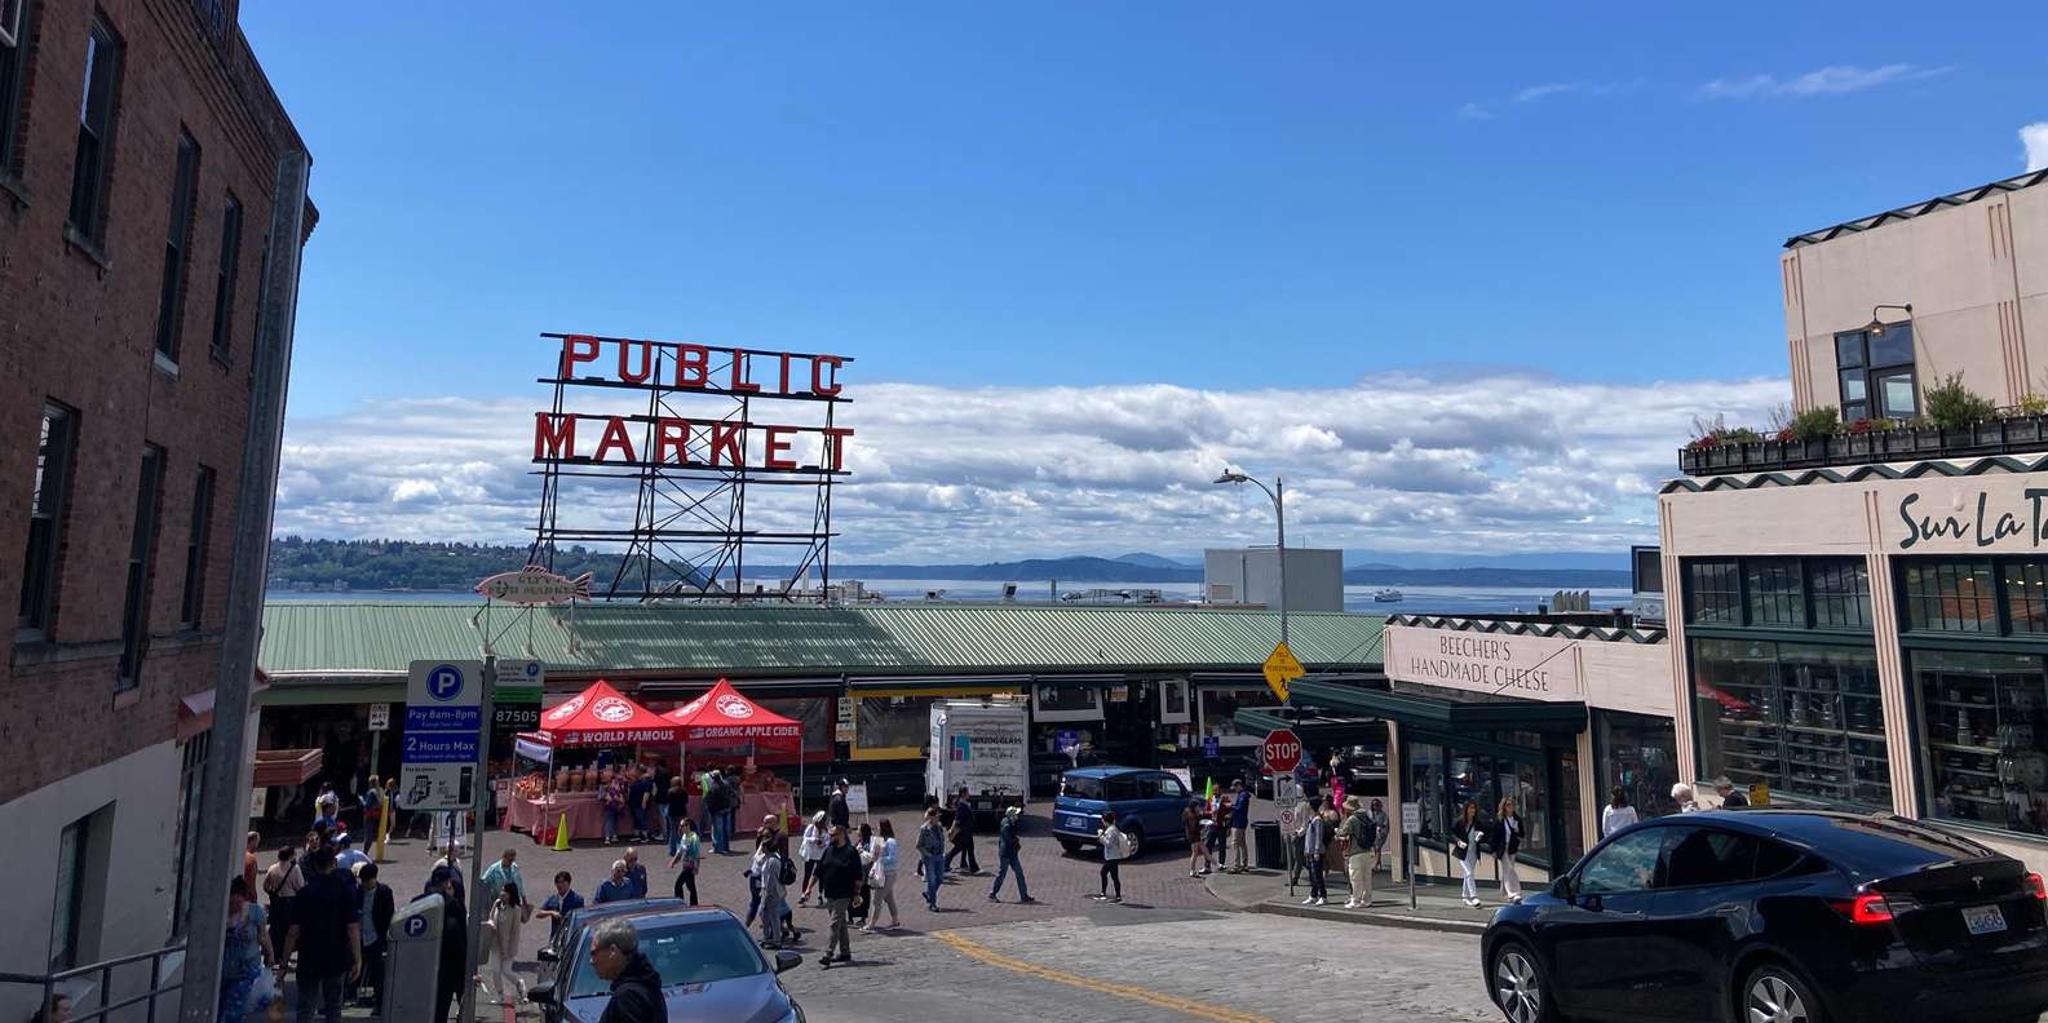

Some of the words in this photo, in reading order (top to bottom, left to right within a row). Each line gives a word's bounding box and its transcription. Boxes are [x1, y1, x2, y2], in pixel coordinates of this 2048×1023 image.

[563, 334, 843, 397] PUBLIC
[533, 411, 855, 471] MARKET
[1900, 493, 1970, 549] Sur
[1977, 491, 2025, 547] La
[2025, 488, 2048, 547] T
[1440, 635, 1512, 661] BEECHER'S
[1411, 657, 1490, 684] HANDMADE
[1494, 664, 1549, 691] CHEESE
[408, 709, 427, 721] Pay
[429, 709, 478, 721] 8am-8pm
[496, 710, 538, 722] 87505
[582, 731, 625, 742] WORLD
[627, 730, 675, 741] FAMOUS
[705, 727, 744, 737] ORGANIC
[744, 726, 771, 737] APPLE
[773, 726, 801, 736] CIDER
[407, 736, 417, 751] 2
[419, 741, 451, 751] Hours
[453, 741, 475, 751] Max
[1266, 743, 1299, 761] STOP
